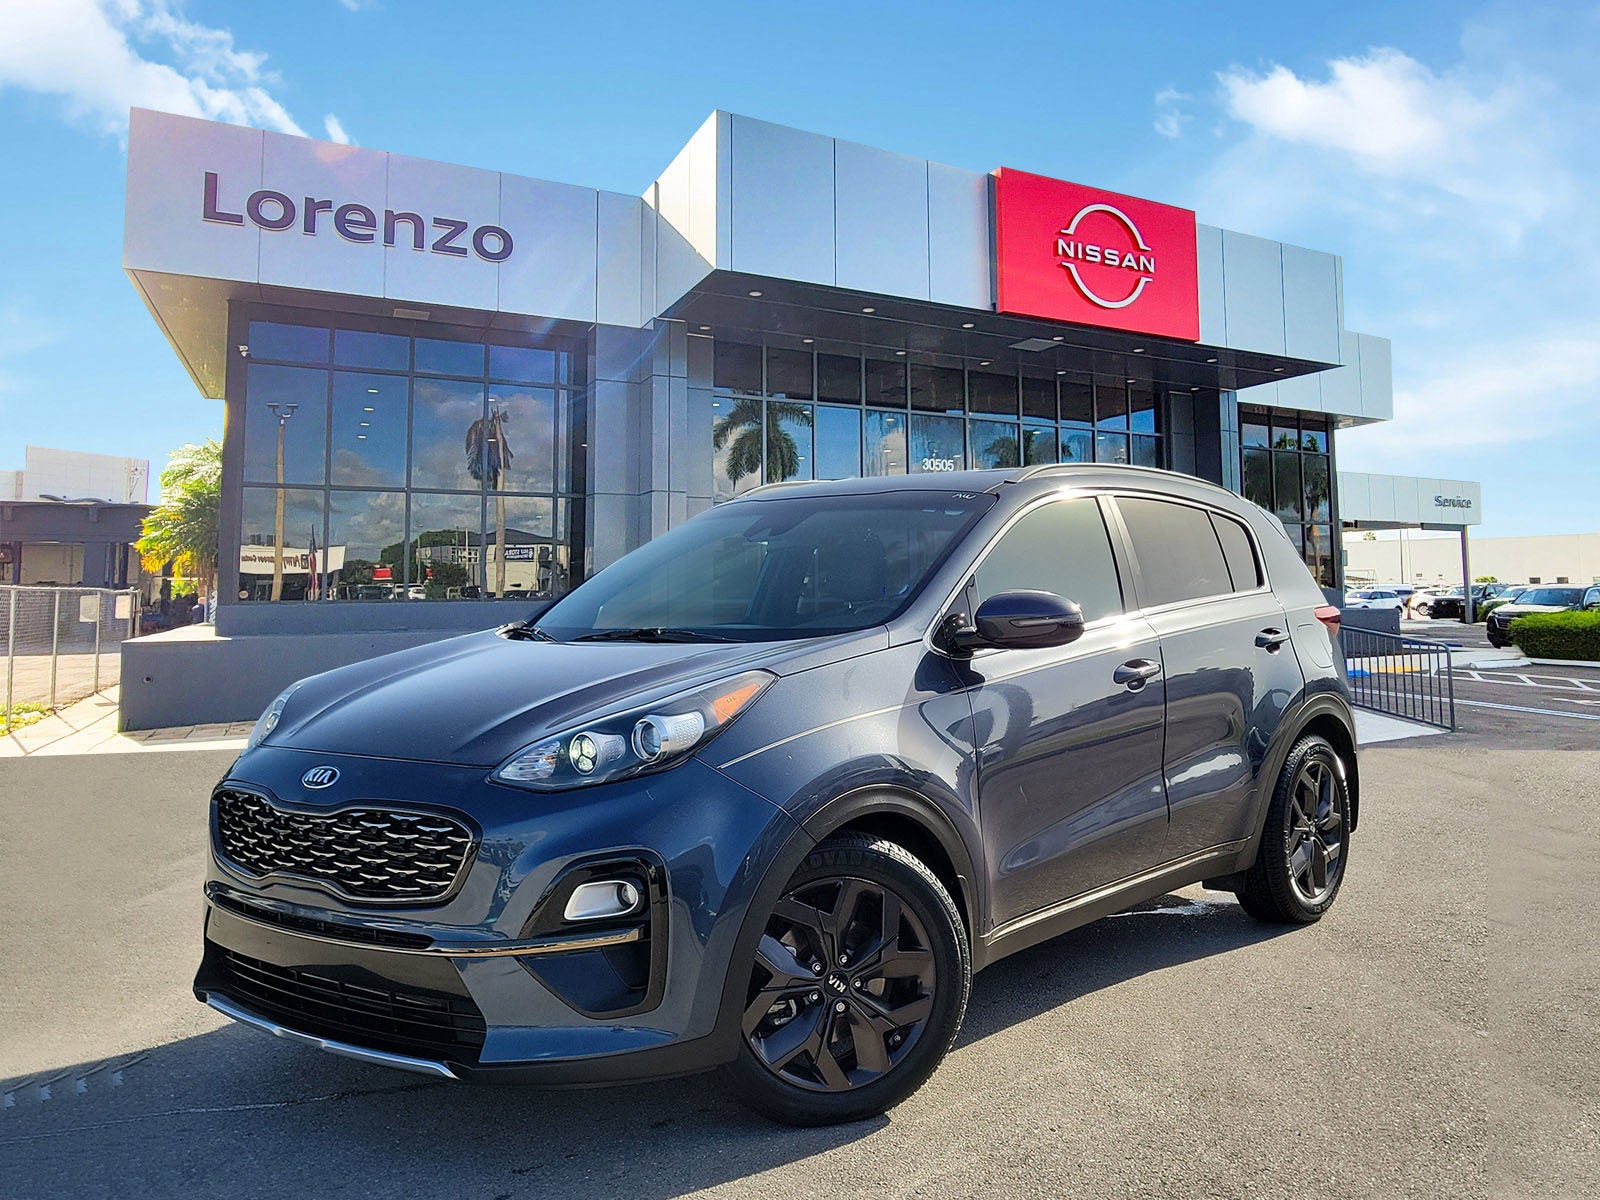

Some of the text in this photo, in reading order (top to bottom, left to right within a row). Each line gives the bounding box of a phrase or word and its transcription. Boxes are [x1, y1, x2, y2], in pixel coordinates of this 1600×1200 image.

[202, 171, 514, 262] Lorenzo
[1057, 238, 1155, 273] NISSAN
[922, 457, 955, 472] 30505
[1434, 495, 1472, 509] Service
[304, 768, 333, 784] KIA
[828, 974, 847, 993] KIA
